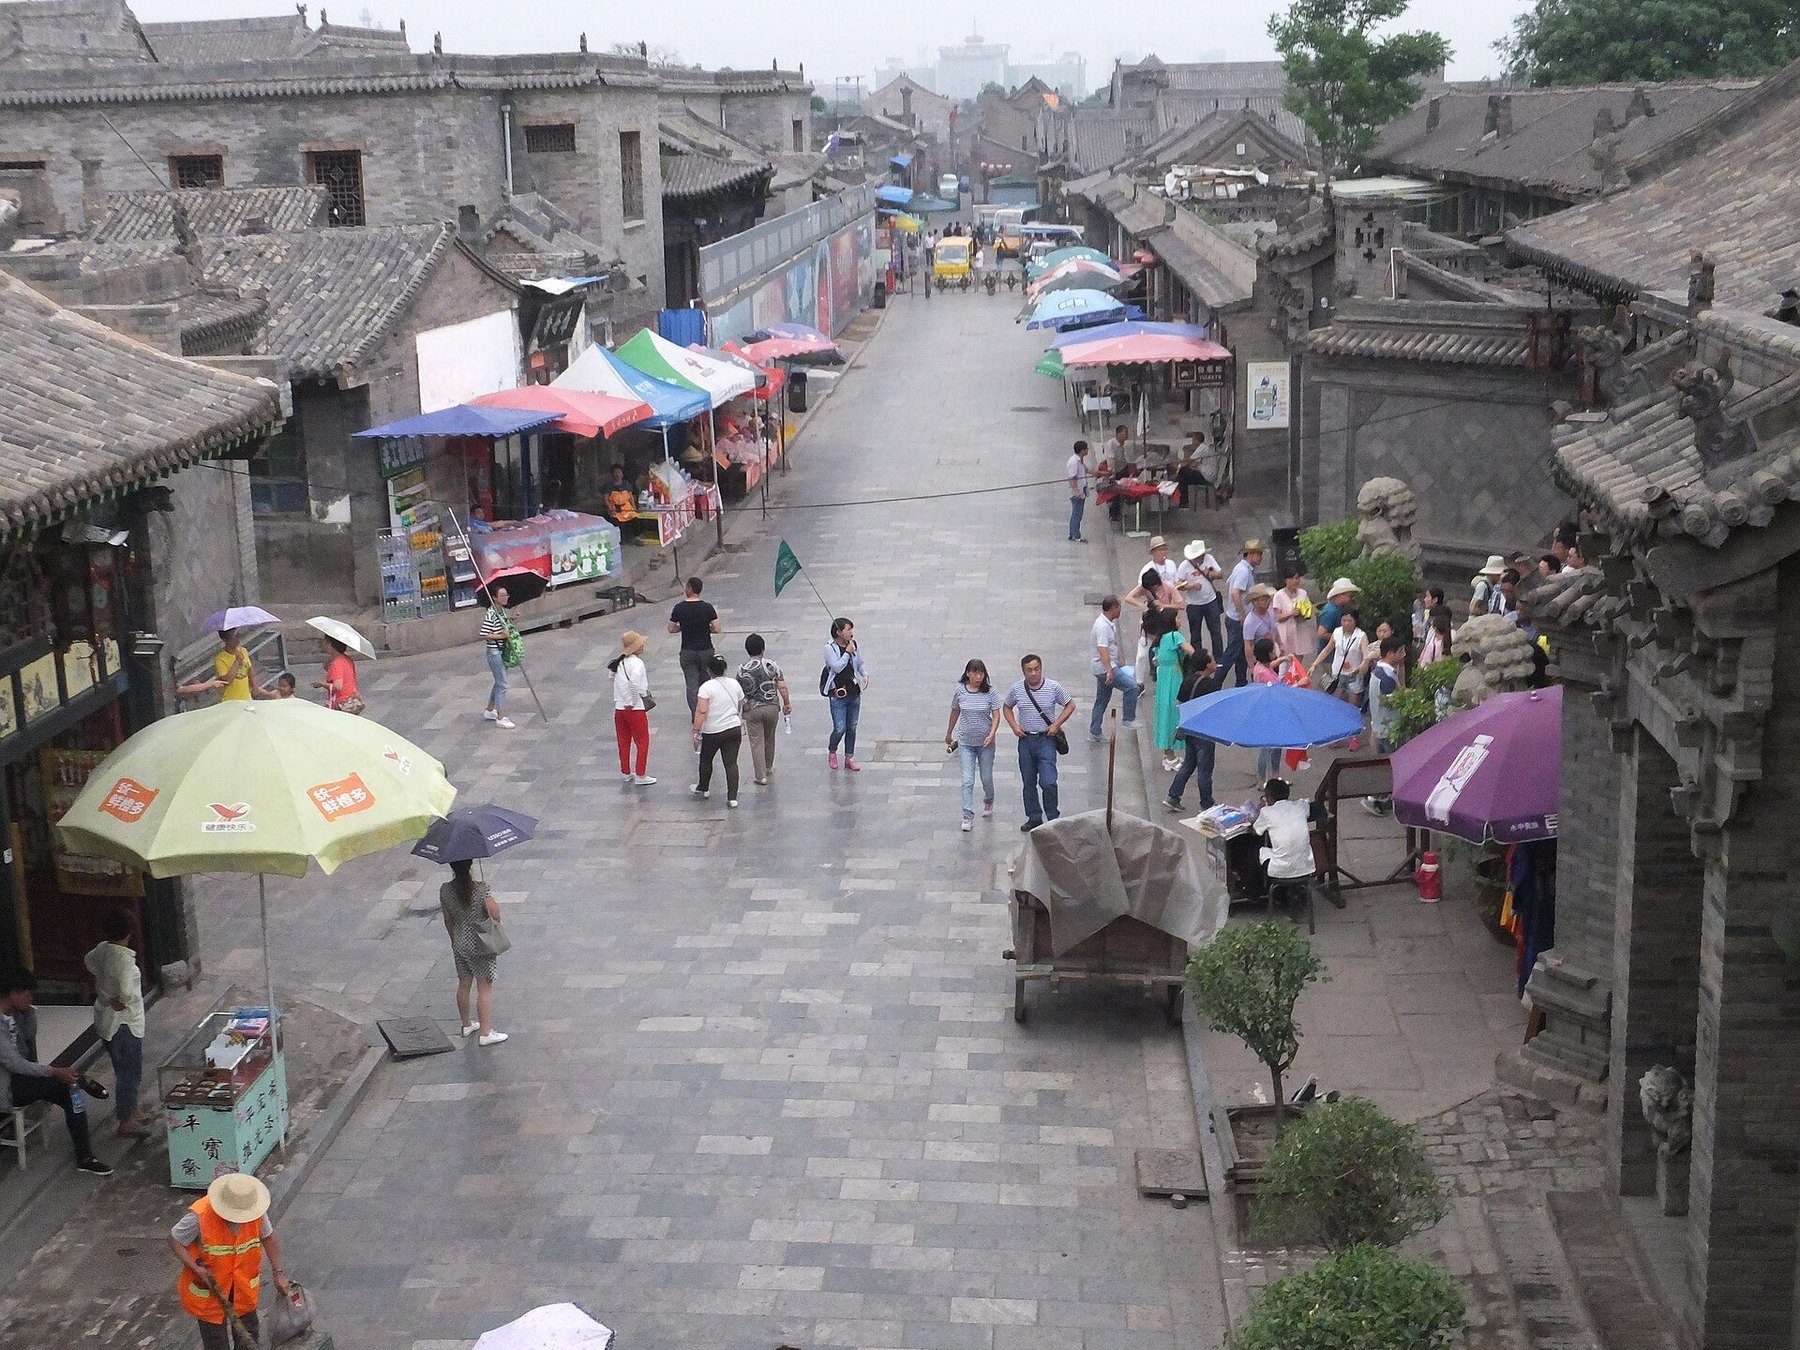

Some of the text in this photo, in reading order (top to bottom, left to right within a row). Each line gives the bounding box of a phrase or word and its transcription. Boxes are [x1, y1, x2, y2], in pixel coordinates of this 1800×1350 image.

[313, 785, 341, 802] 统一
[322, 787, 367, 815] 鲜橙多
[205, 823, 248, 832] 健康快乐
